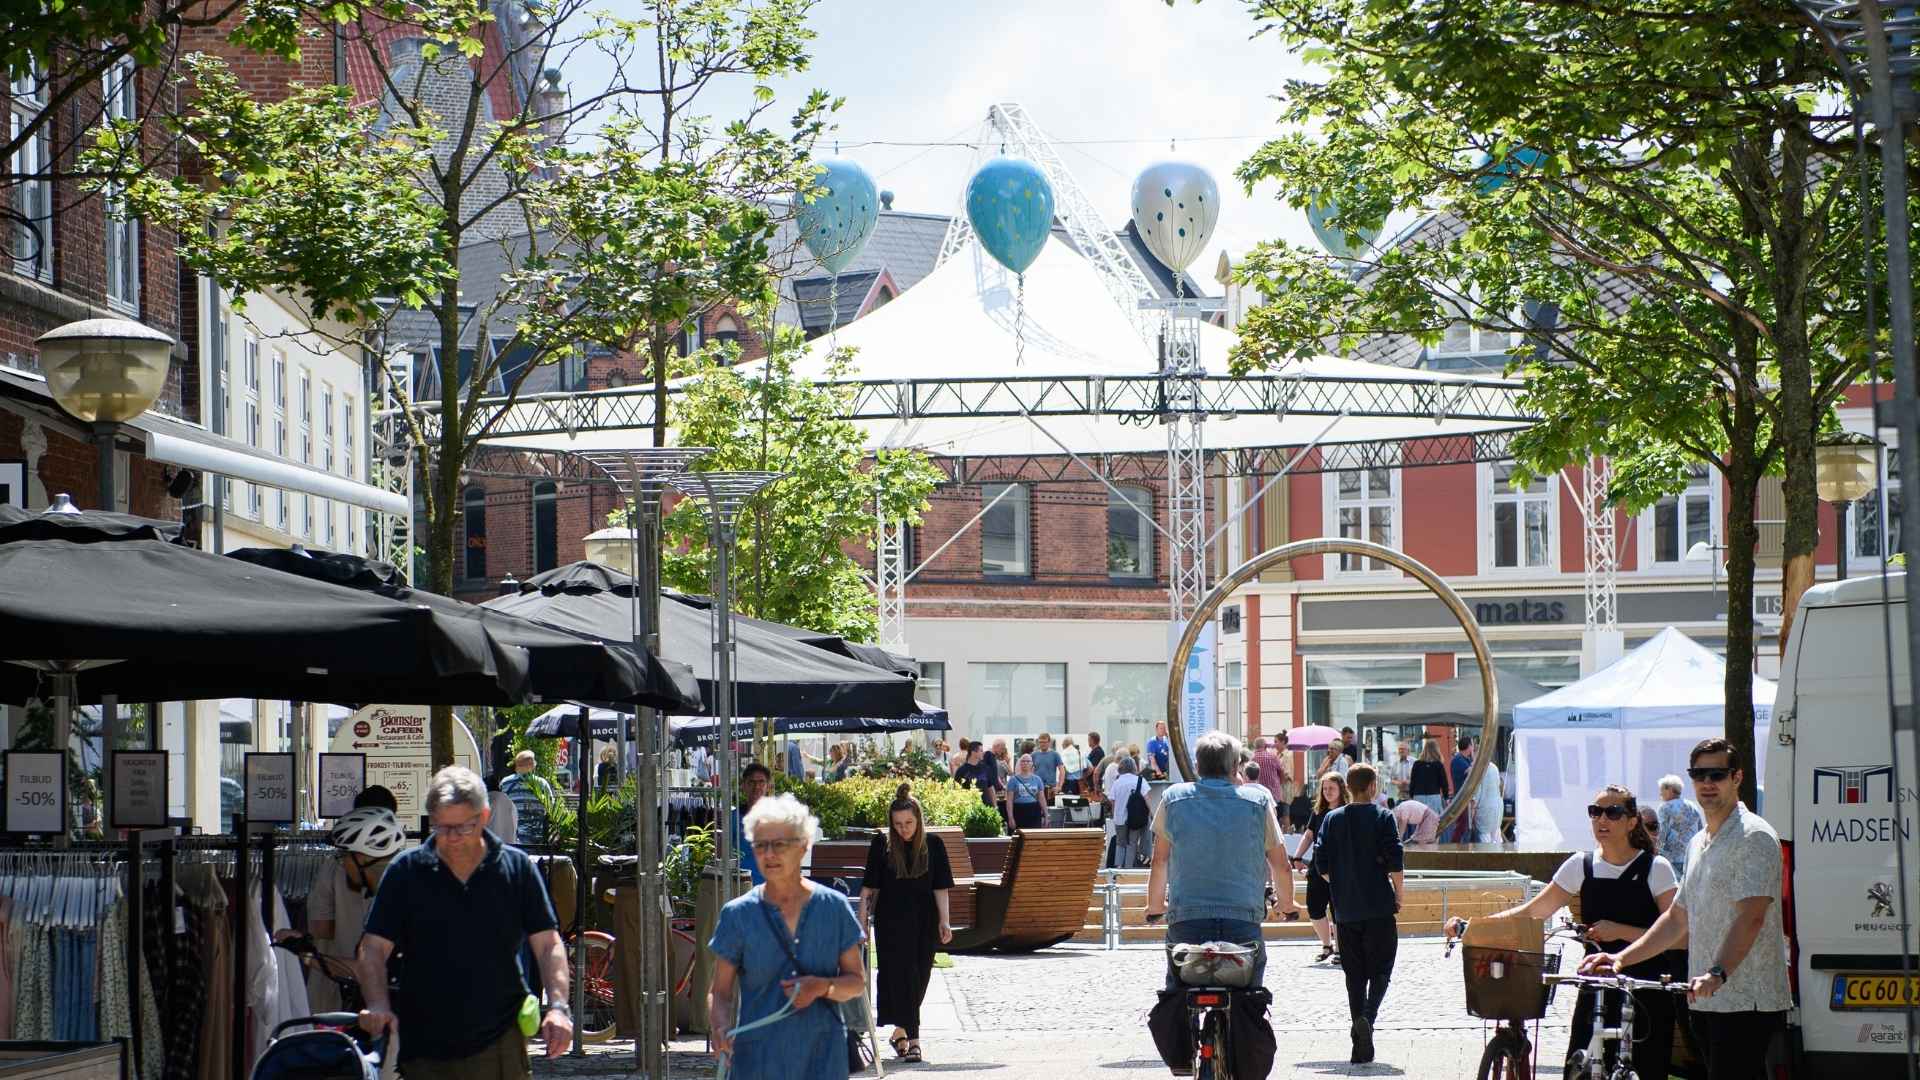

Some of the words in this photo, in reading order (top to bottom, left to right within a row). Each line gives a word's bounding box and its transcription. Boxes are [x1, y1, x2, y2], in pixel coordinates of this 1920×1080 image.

[1476, 599, 1565, 622] matas
[1188, 697, 1196, 736] HANDEL
[19, 775, 52, 784] TILBUD
[257, 773, 284, 781] TILBUD
[254, 787, 288, 799] -50%
[327, 785, 359, 797] -50%
[16, 791, 56, 806] -50%
[1811, 818, 1910, 842] MADSEN
[1854, 923, 1912, 932] PEUGEOT
[1847, 980, 1872, 1000] CG
[1876, 979, 1898, 1000] 60
